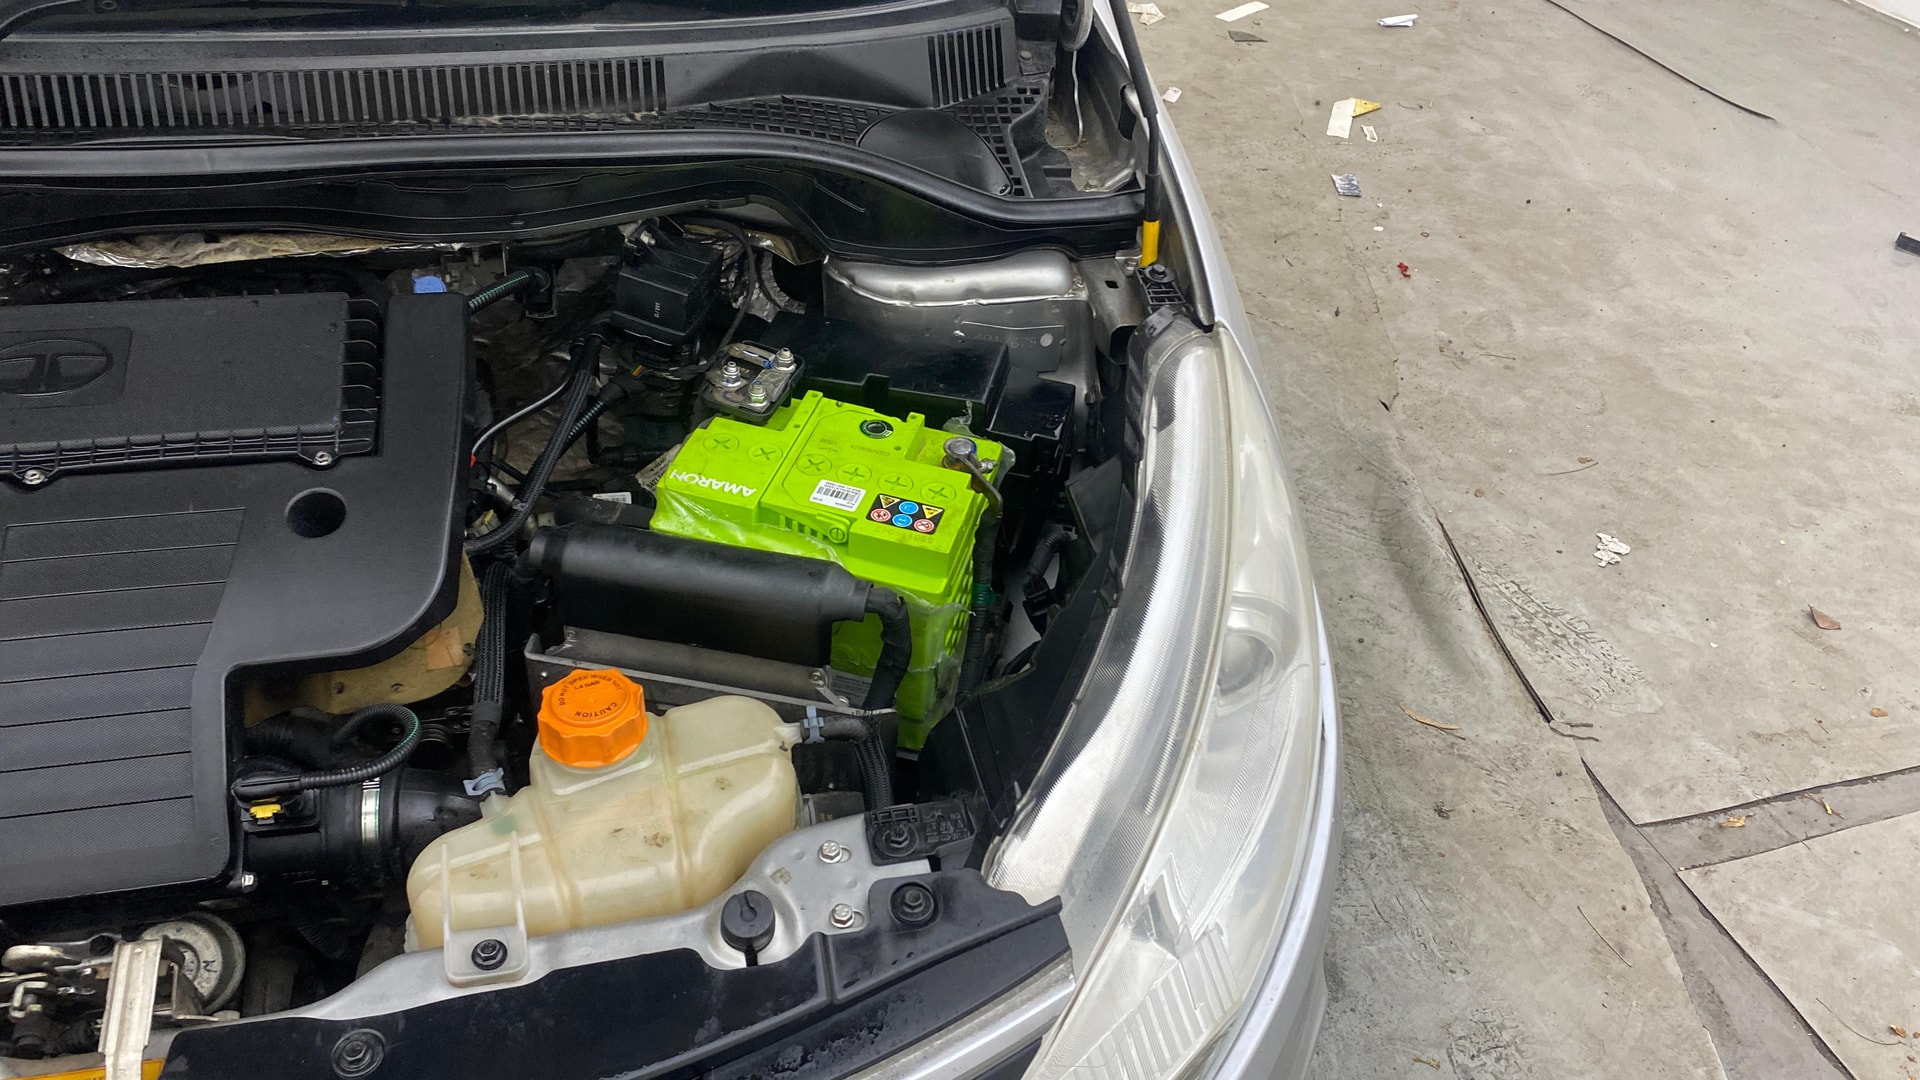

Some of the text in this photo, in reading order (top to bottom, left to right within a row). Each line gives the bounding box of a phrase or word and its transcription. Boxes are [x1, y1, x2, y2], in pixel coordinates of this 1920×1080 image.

[669, 469, 757, 497] AMARON
[569, 676, 588, 685] OPEN
[575, 703, 617, 717] CAUTION
